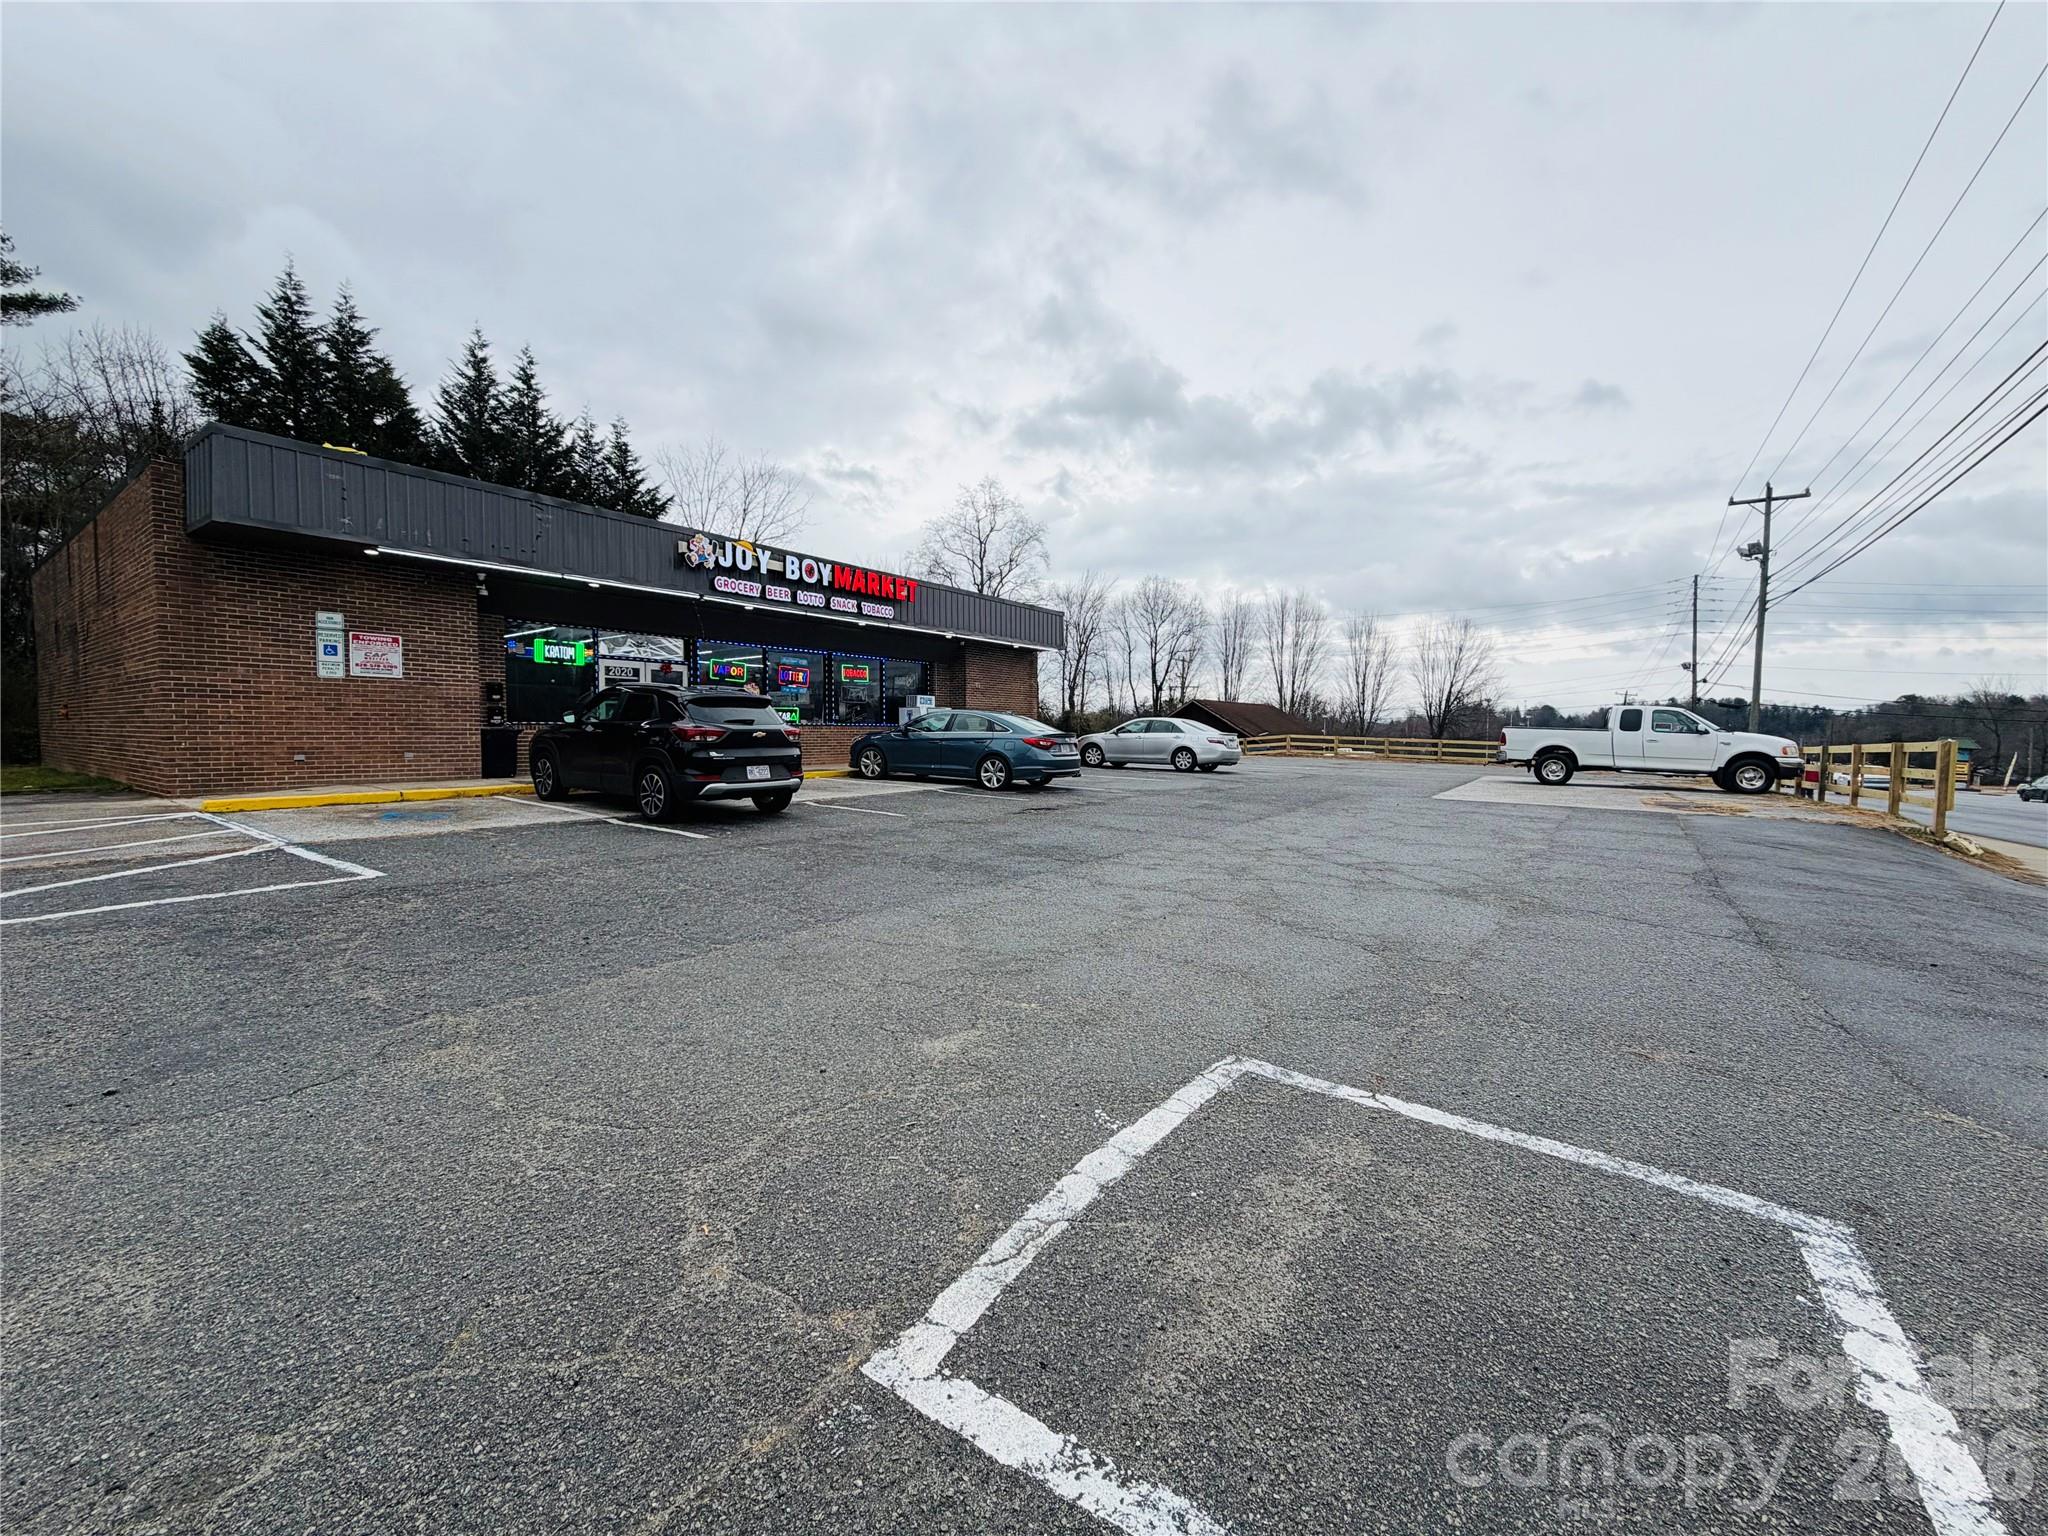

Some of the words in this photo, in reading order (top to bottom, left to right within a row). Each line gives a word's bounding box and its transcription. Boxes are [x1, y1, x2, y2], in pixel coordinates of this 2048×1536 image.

[718, 541, 772, 574] JOY
[786, 555, 833, 586] BOY
[834, 564, 919, 602] MARKET
[716, 578, 760, 596] GROCERY
[767, 587, 790, 600] BEER
[798, 592, 825, 606] LOTTO
[831, 598, 857, 611] SNACK
[862, 604, 894, 618] TOBACCO
[353, 639, 399, 648] ENFORCED
[544, 645, 575, 660] KRATOM
[608, 667, 634, 678] 2020
[713, 664, 744, 677] VAPOR
[780, 670, 807, 683] LOTTERY
[843, 668, 867, 679] TOBACCO
